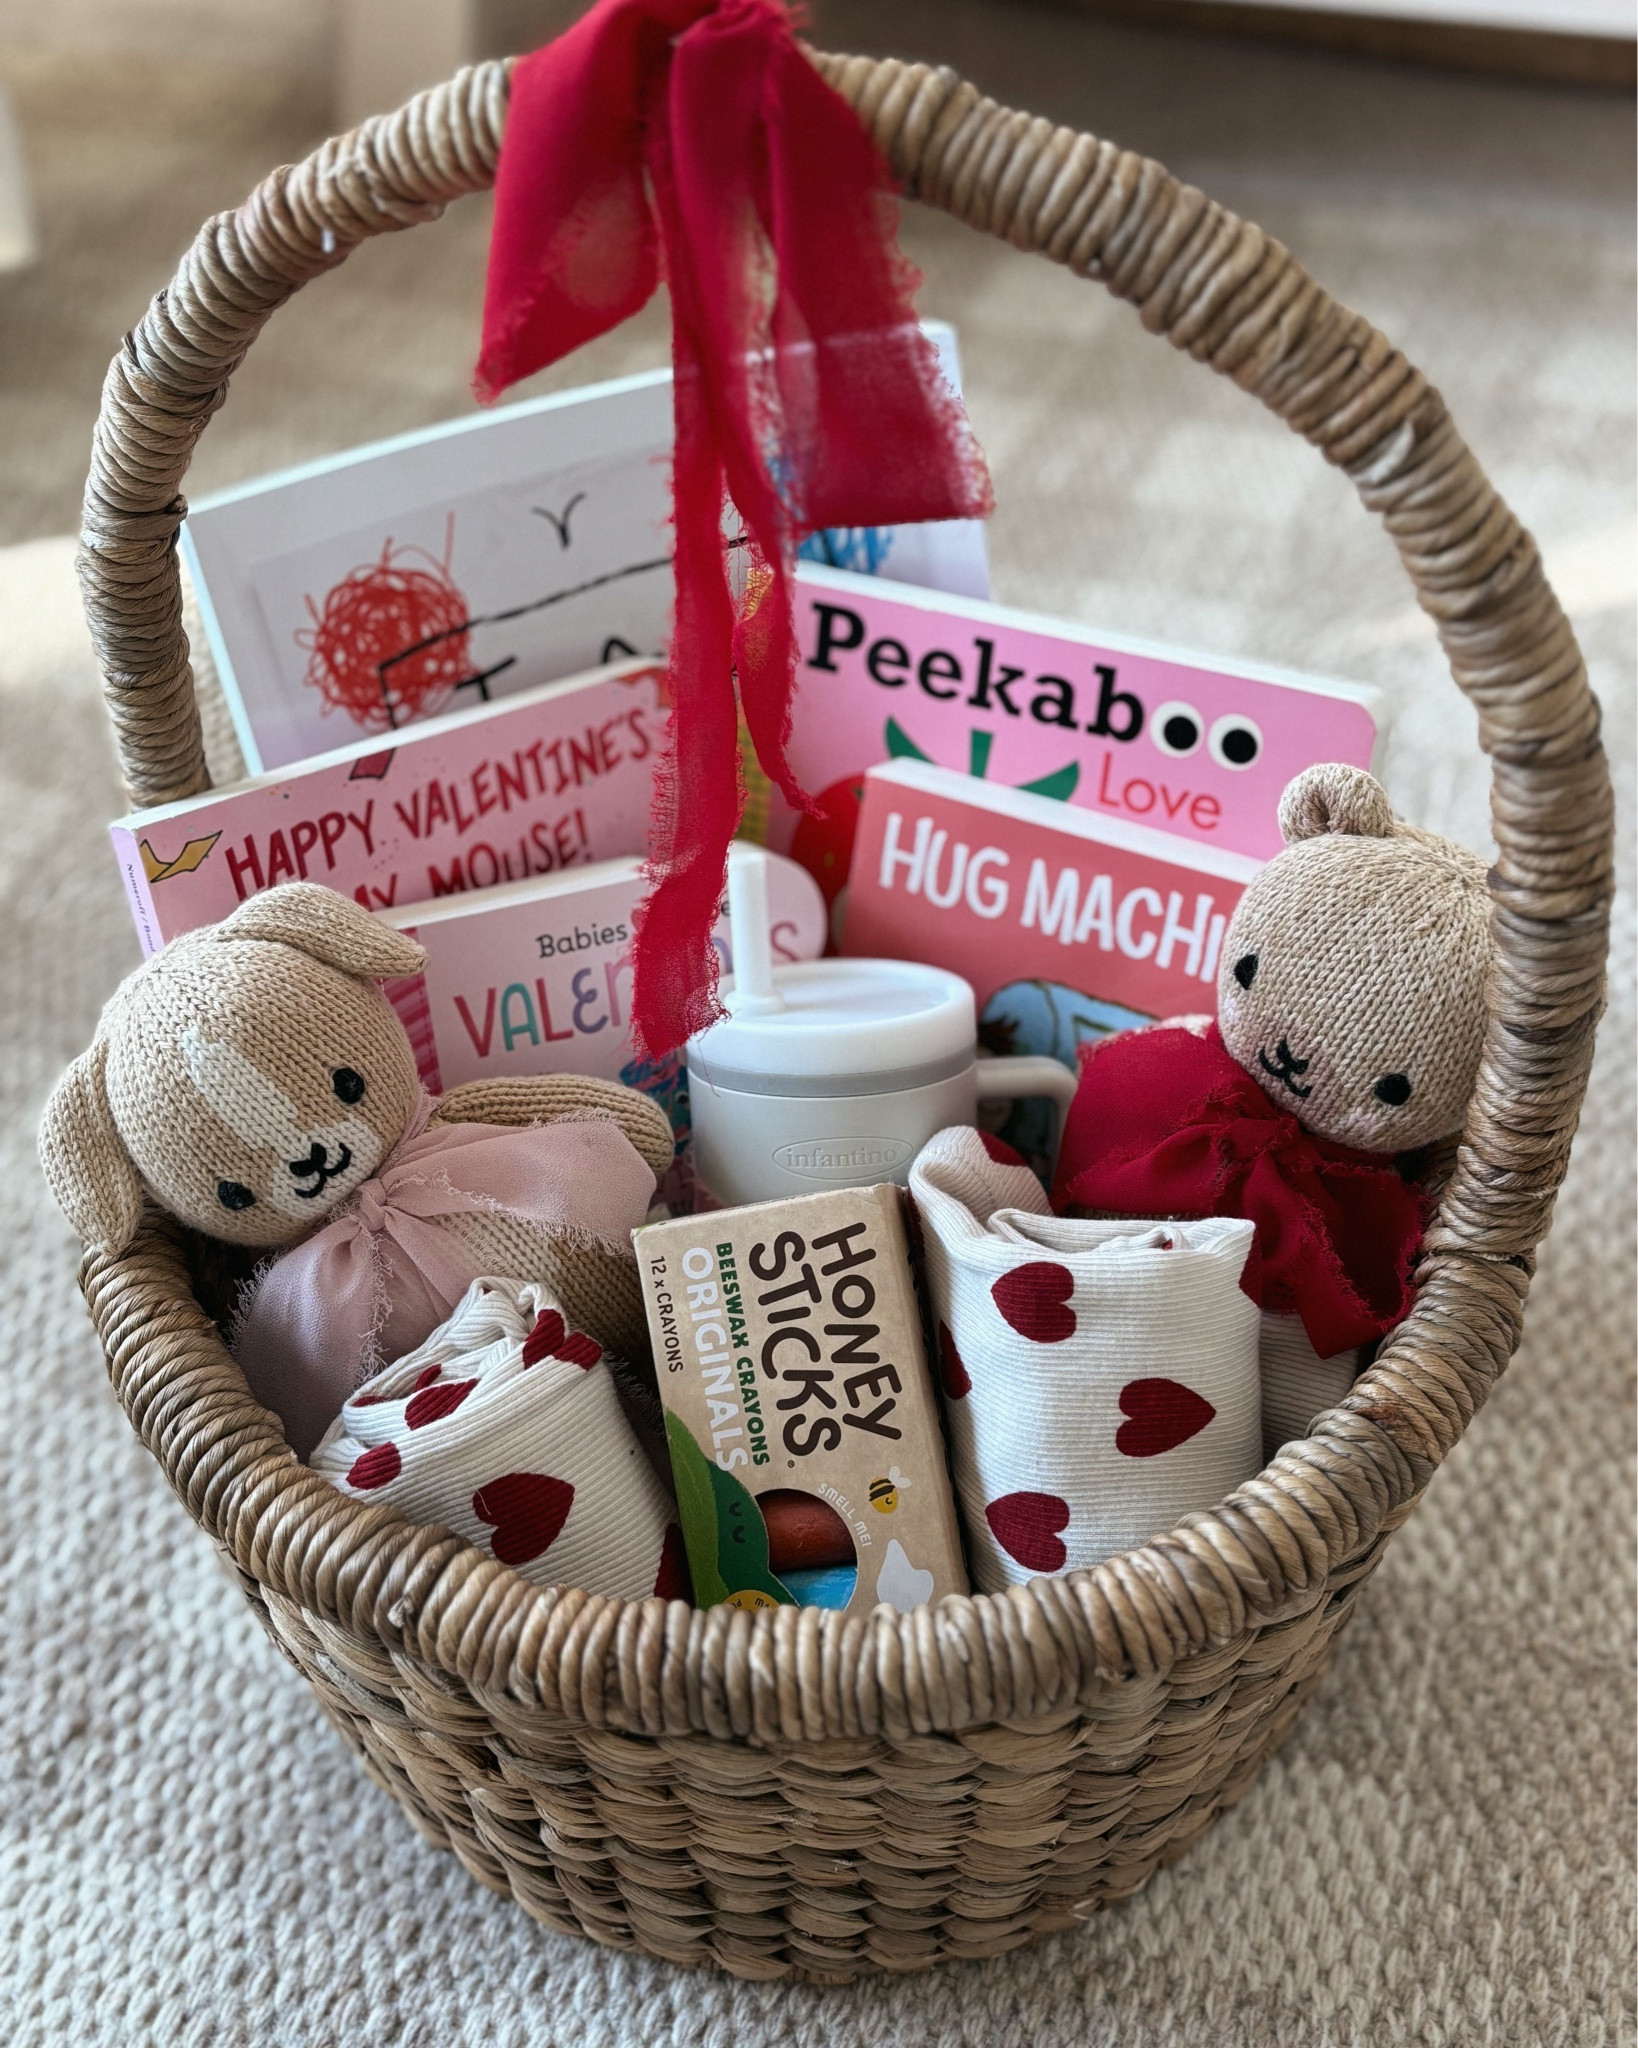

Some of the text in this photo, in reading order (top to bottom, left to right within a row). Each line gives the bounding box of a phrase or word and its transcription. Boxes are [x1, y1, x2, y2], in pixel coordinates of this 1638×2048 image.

[224, 708, 651, 902] HAPPY VALENTINE'S
[1099, 751, 1222, 832] Love
[428, 808, 593, 898] MOUSE!
[879, 812, 1226, 984] HUG MACHI
[535, 922, 628, 959] Babies
[786, 1147, 898, 1168] infantino
[651, 1255, 667, 1275] 12
[656, 1292, 684, 1373] CRAYONS
[682, 1247, 748, 1472] ORIGINALS
[716, 1242, 770, 1466] BEESWAX CRAYONS
[749, 1231, 842, 1456] STICKS
[811, 1222, 902, 1440] HONEY
[818, 1482, 856, 1520] SMELL
